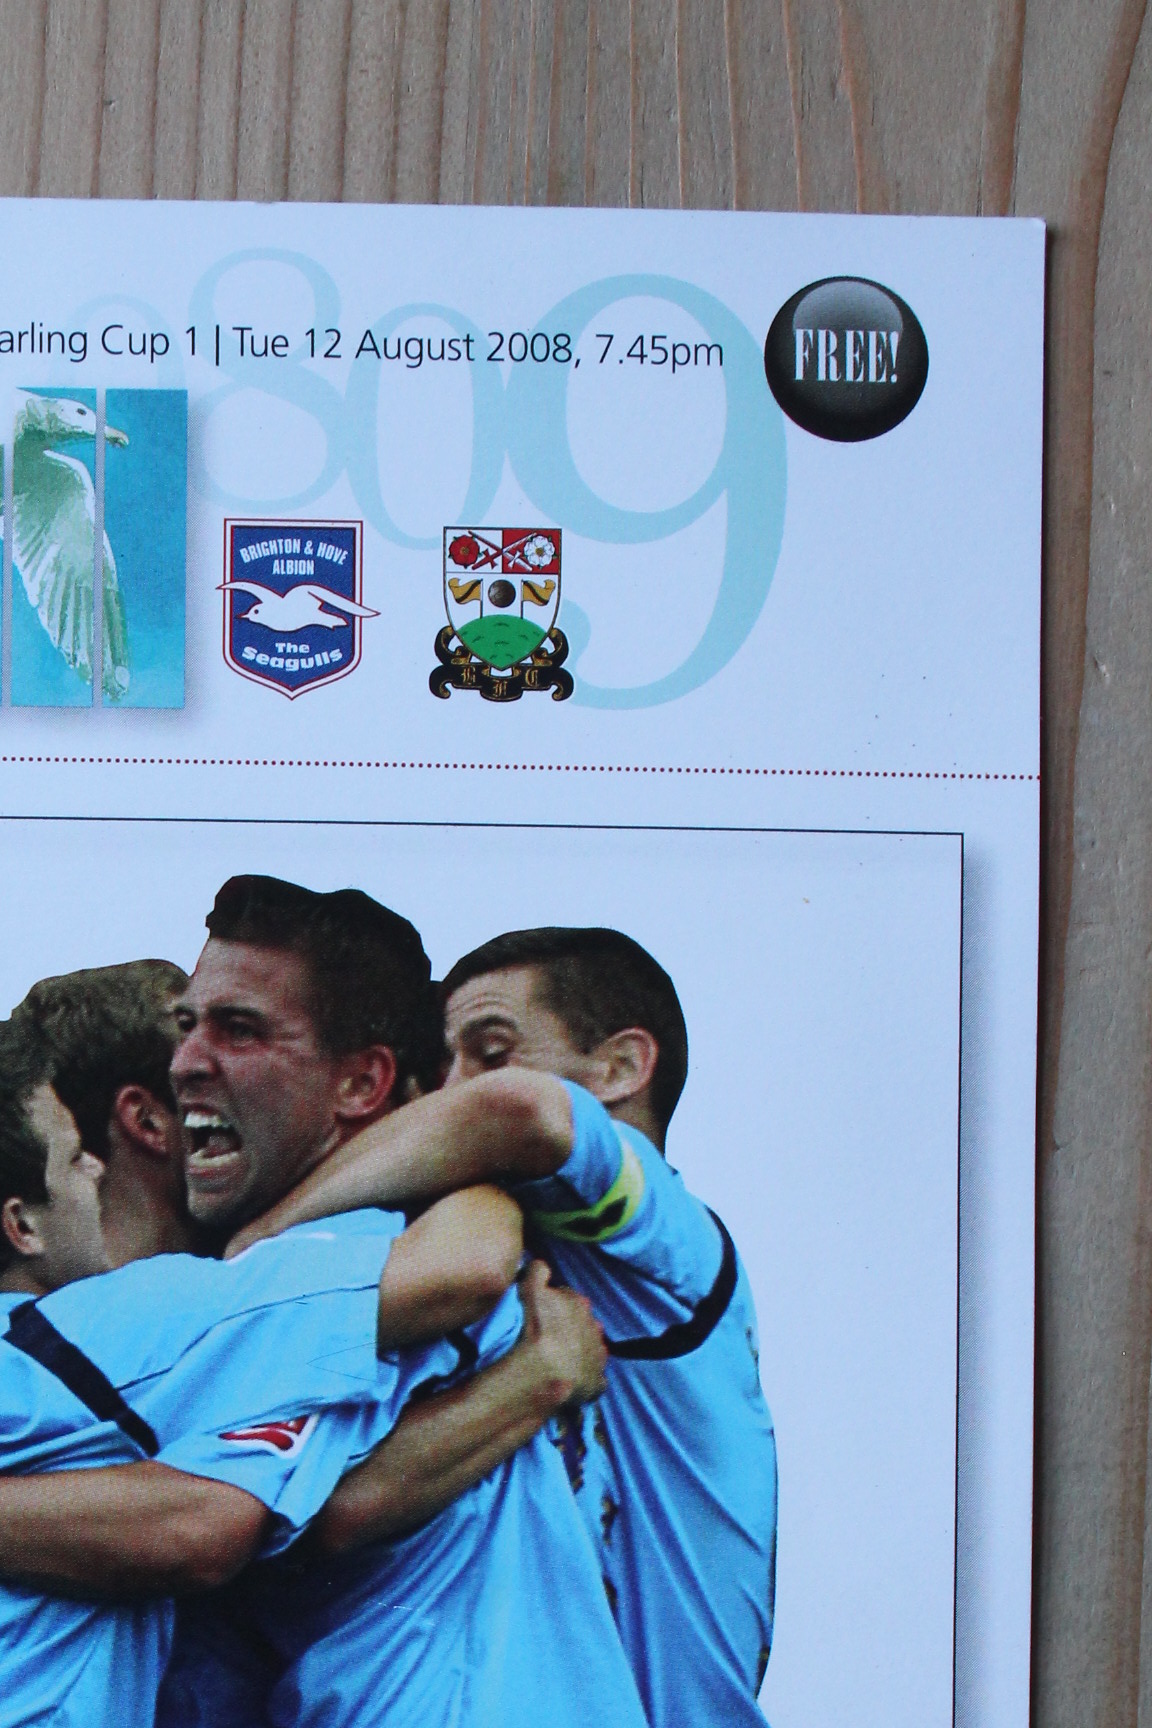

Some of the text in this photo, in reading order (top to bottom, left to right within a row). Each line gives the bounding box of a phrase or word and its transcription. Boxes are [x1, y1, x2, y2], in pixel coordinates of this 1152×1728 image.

[101, 324, 170, 364] Cup
[185, 326, 196, 356] 1
[232, 326, 289, 358] Tue
[305, 327, 342, 359] 12
[354, 328, 475, 369] August
[486, 331, 581, 369] 2008,
[595, 333, 724, 374] 7.45pm
[793, 328, 900, 384] FREE!
[239, 538, 348, 565] BRIGHTON & HOVE
[272, 559, 315, 575] ALBION
[242, 646, 343, 671] Seagulls
[275, 642, 310, 653] The
